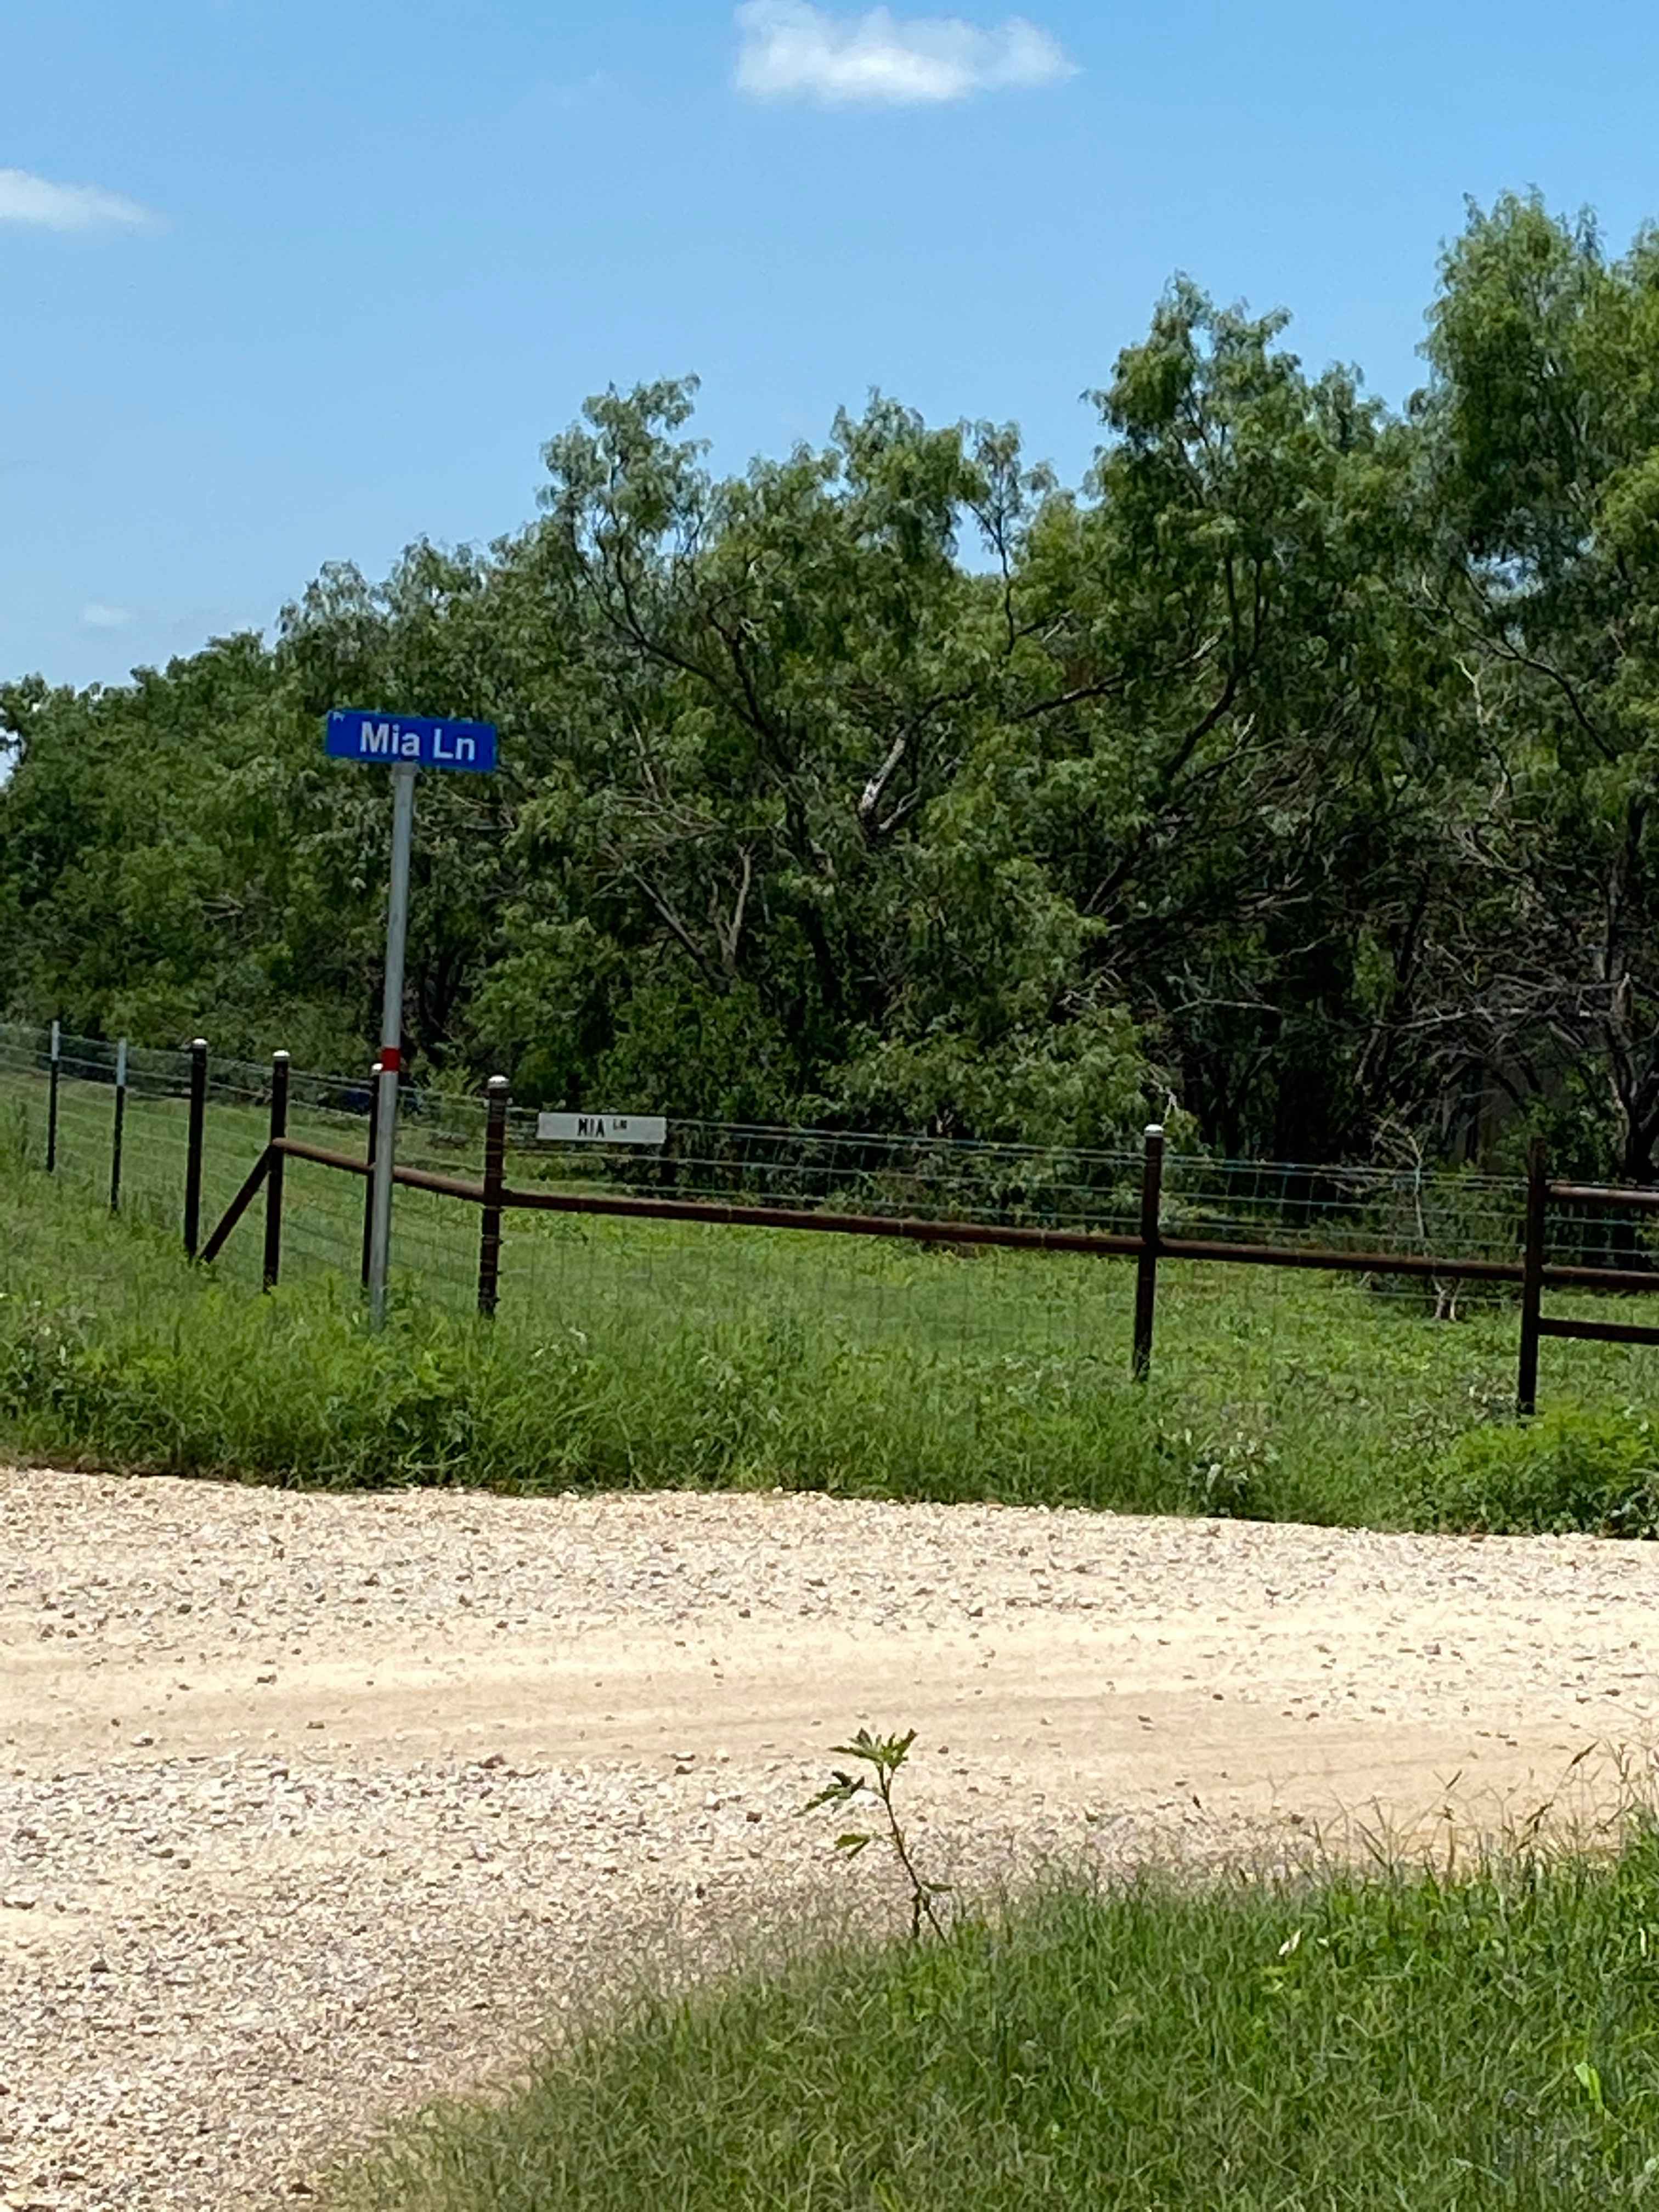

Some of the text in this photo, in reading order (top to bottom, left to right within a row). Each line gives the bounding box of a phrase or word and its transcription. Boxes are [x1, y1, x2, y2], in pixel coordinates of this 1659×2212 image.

[360, 721, 475, 760] Mia Ln
[577, 1118, 605, 1138] MIA
